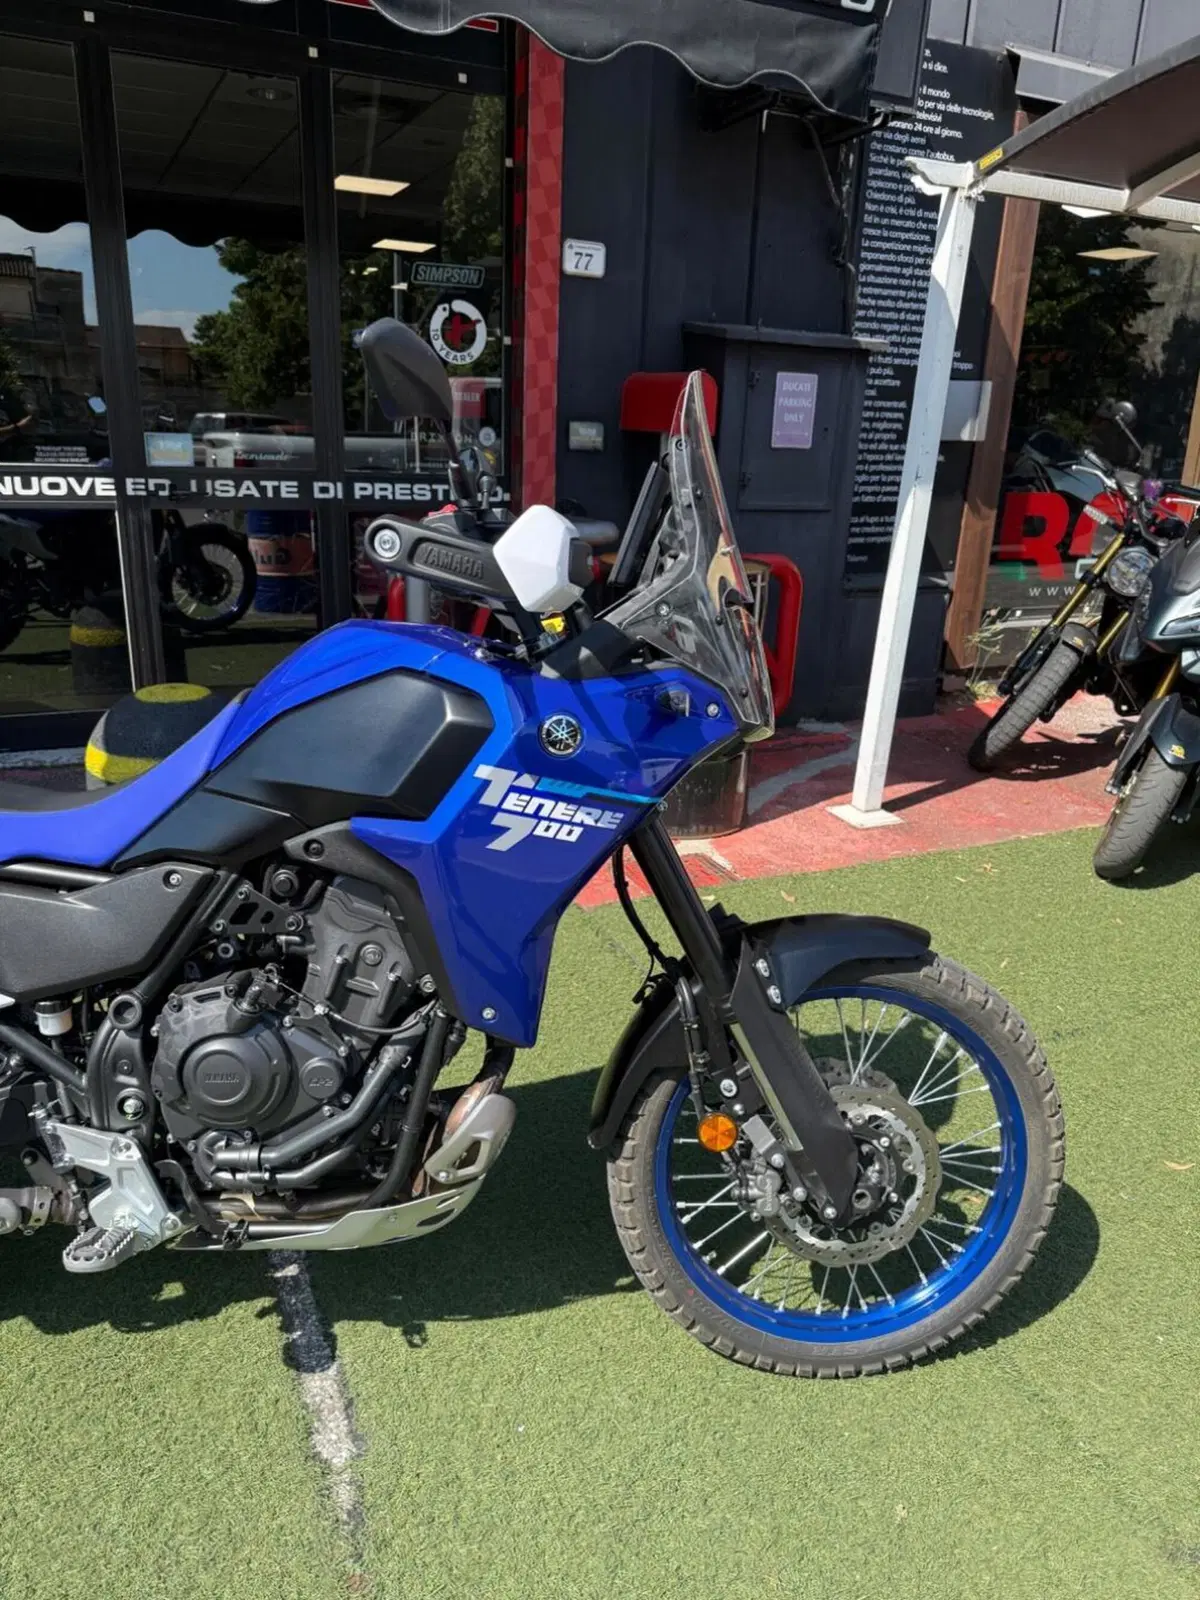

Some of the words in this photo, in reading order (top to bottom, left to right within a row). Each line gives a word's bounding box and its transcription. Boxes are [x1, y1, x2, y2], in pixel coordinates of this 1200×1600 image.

[928, 87, 950, 99] mondo
[925, 100, 935, 109] per
[936, 100, 945, 110] via
[946, 102, 961, 114] delle
[884, 131, 893, 139] via
[893, 131, 909, 144] degli
[914, 122, 922, 131] 24
[923, 125, 934, 134] ore
[935, 126, 941, 135] al
[941, 127, 963, 139] giorno.
[870, 141, 883, 150] che
[883, 143, 908, 154] costano
[908, 147, 925, 157] come
[866, 178, 899, 191] capiscono
[866, 189, 896, 202] Chiedono
[865, 202, 878, 212] Non
[904, 207, 915, 216] crisi
[864, 213, 872, 223] Ed
[873, 214, 880, 224] in
[891, 219, 916, 229] mercato
[916, 220, 927, 230] che
[862, 227, 881, 237] cresce
[889, 231, 931, 241] competizione.
[861, 237, 869, 247] La
[870, 240, 912, 252] competizione
[574, 251, 594, 272] 77
[860, 249, 897, 262] imponendo
[914, 257, 925, 265] per
[416, 265, 480, 285] SIMPSON
[858, 273, 866, 282] La
[867, 308, 876, 318] chi
[439, 345, 475, 362] YEARS
[782, 381, 812, 393] DUCATI
[778, 396, 813, 408] PARKING
[783, 411, 805, 424] ONLY
[312, 481, 344, 499] DI
[423, 545, 485, 581] YAMAHA
[485, 811, 585, 852] 700
